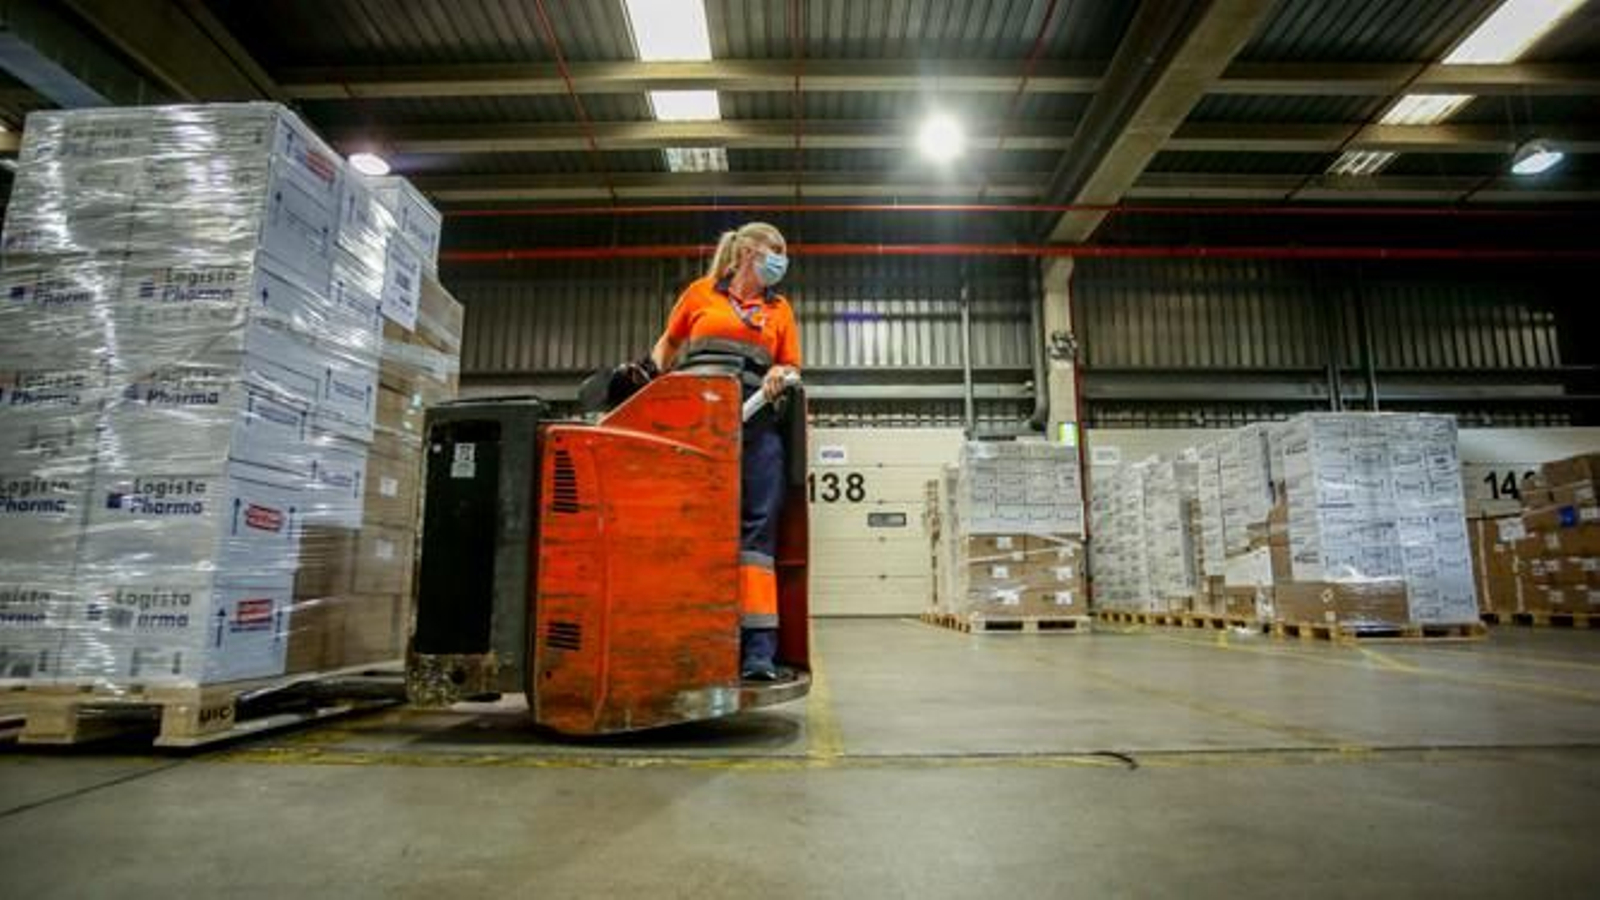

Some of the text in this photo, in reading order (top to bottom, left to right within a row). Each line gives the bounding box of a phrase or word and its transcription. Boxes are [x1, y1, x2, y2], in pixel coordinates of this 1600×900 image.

[166, 267, 237, 284] Logista
[147, 389, 219, 404] Pharma
[133, 478, 206, 497] Logista
[807, 472, 866, 503] 138
[130, 498, 203, 515] Pharma
[115, 586, 192, 608] Logista
